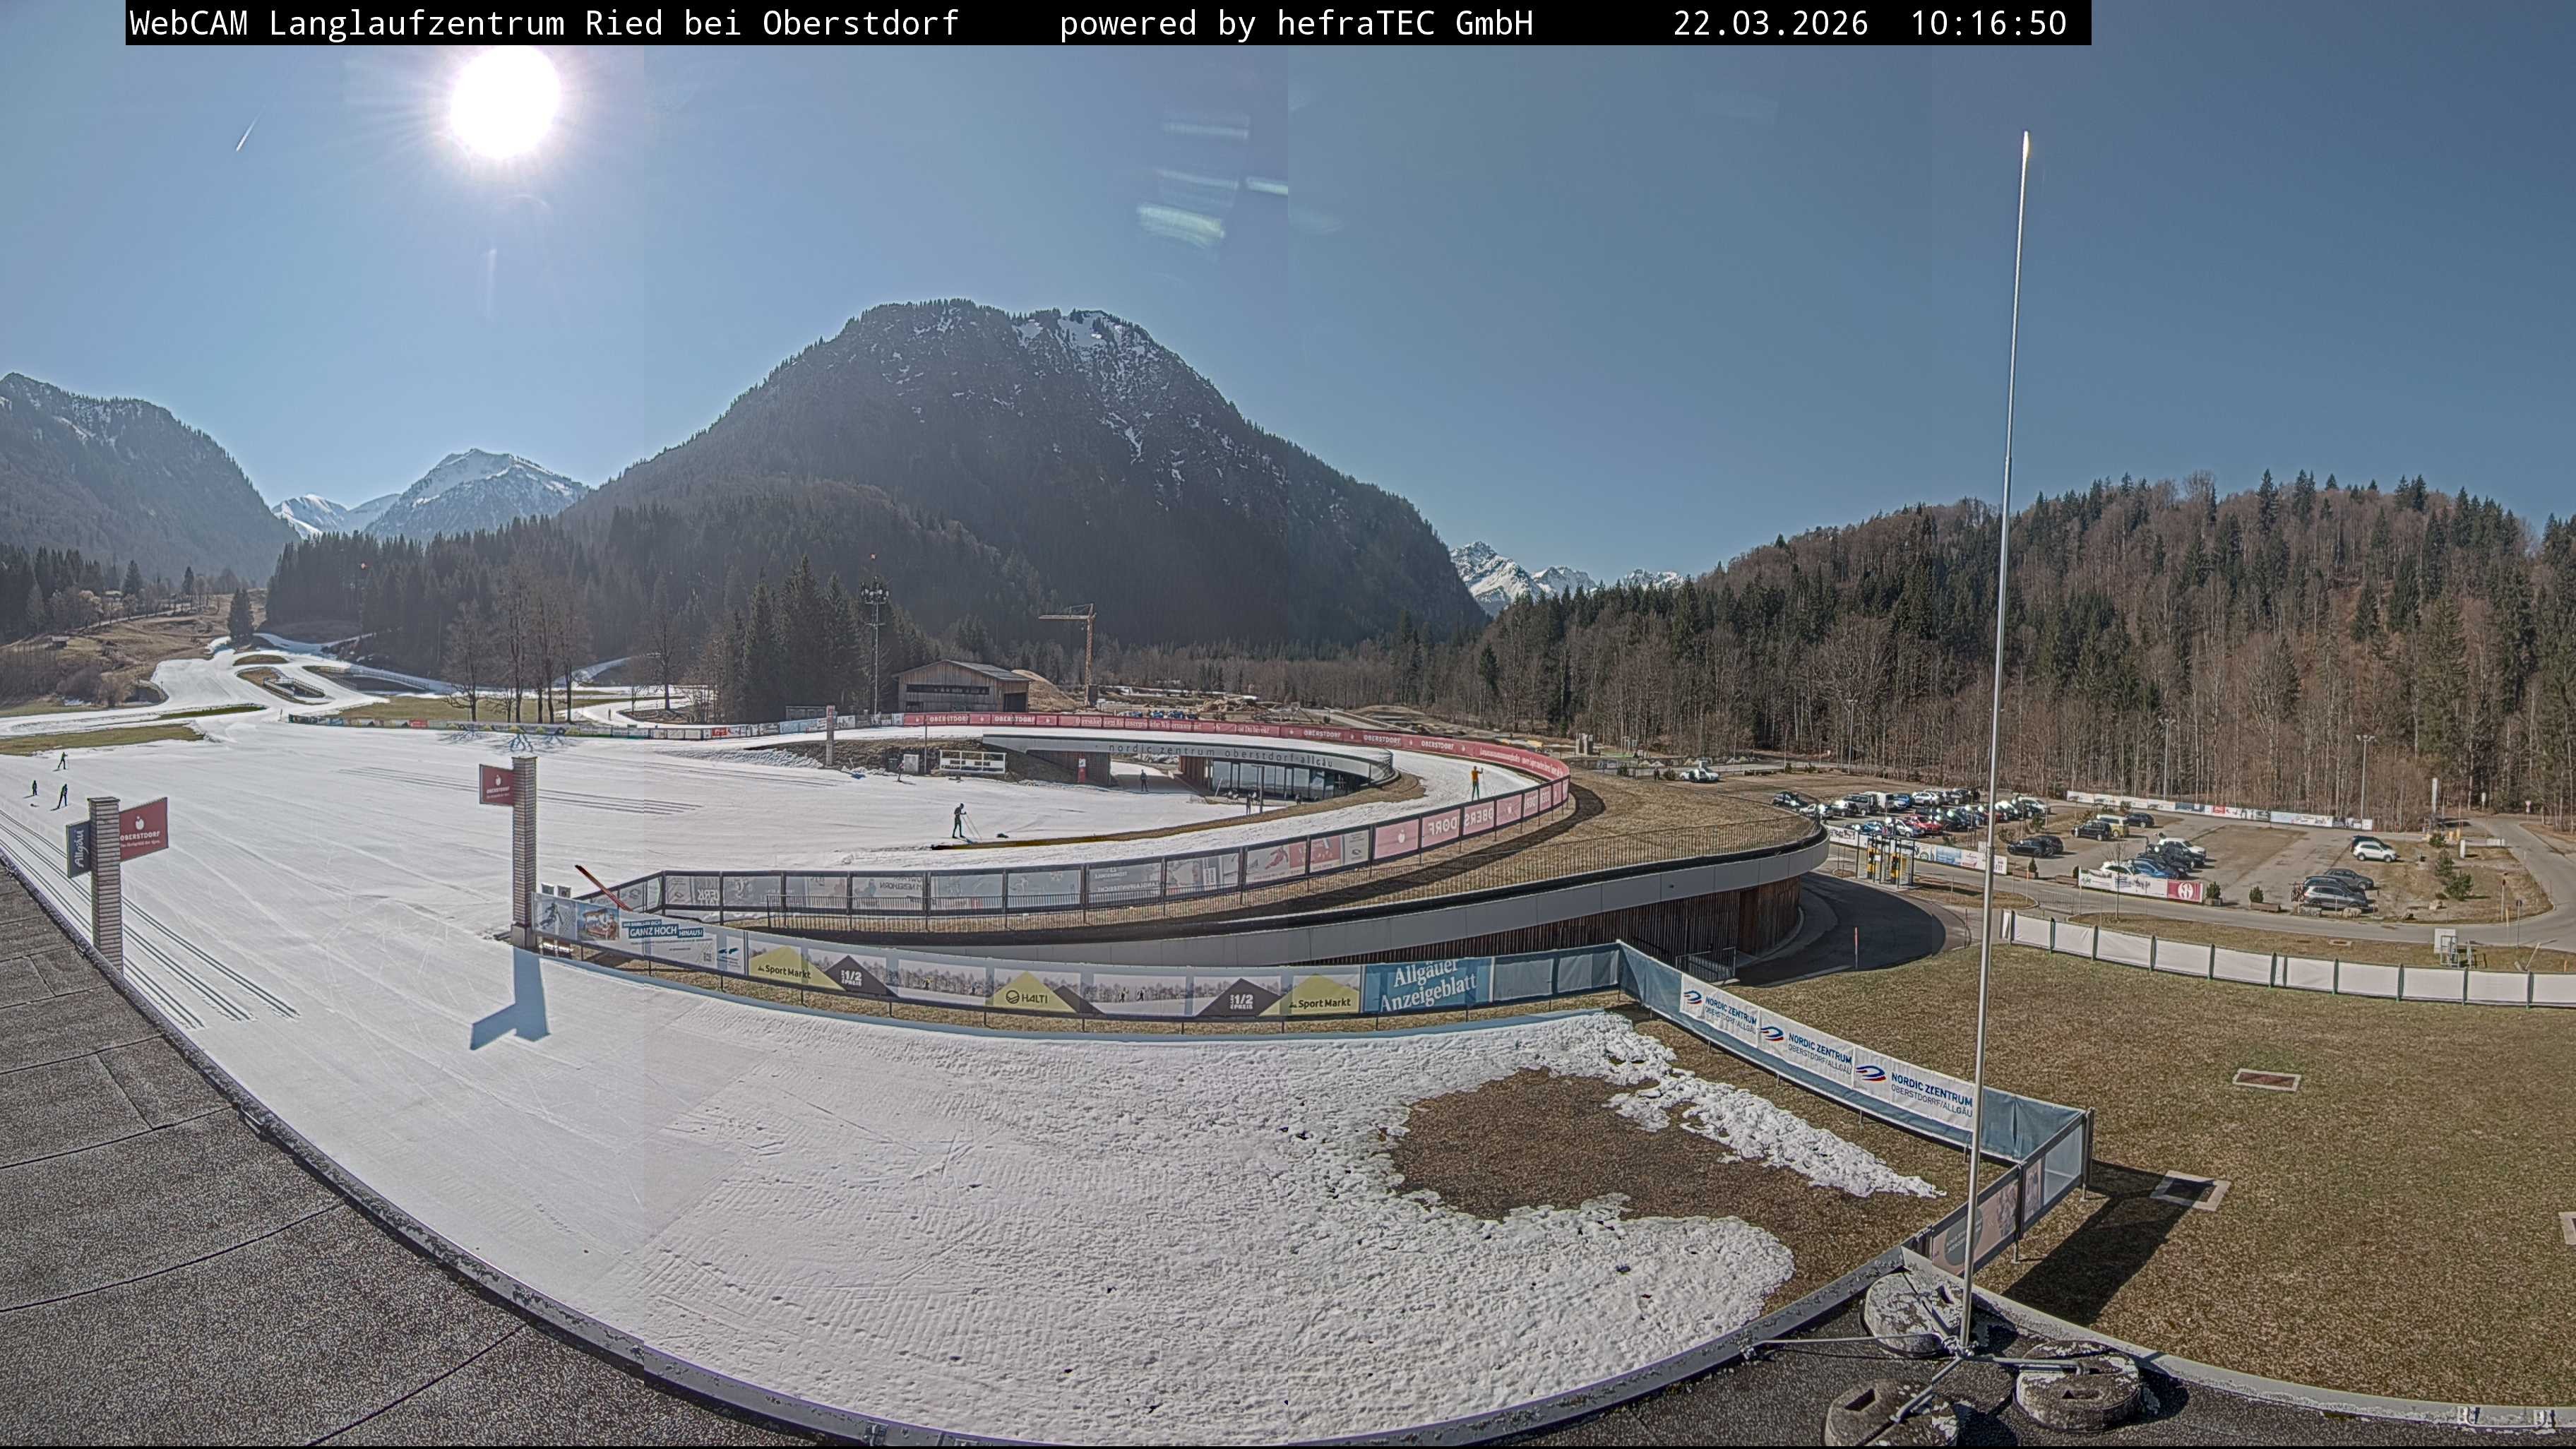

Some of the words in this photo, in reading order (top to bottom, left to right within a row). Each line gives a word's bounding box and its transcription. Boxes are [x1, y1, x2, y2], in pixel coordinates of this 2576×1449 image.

[1109, 744, 1152, 753] nordic
[1157, 746, 1215, 756] zentrum
[119, 830, 160, 841] OBERSTDORF
[73, 829, 90, 868] Allgäu
[654, 926, 677, 936] HOCH
[765, 965, 787, 975] Sport
[788, 968, 811, 979] Markt
[845, 970, 861, 981] 1/2
[1393, 960, 1460, 988] Allgäuer
[1021, 994, 1048, 1003] HALTI
[1234, 994, 1254, 1004] 1/2
[1380, 973, 1479, 1013] Anzeigeblatt
[1298, 999, 1324, 1009] Sport
[1325, 998, 1352, 1007] Markt
[1705, 996, 1728, 1012] NORDIC
[1728, 1006, 1758, 1025] ZENTRUM
[1789, 1032, 1815, 1050] NORDIC
[1816, 1044, 1852, 1065] ZENTRUM
[1891, 1072, 1924, 1091] NORDIC
